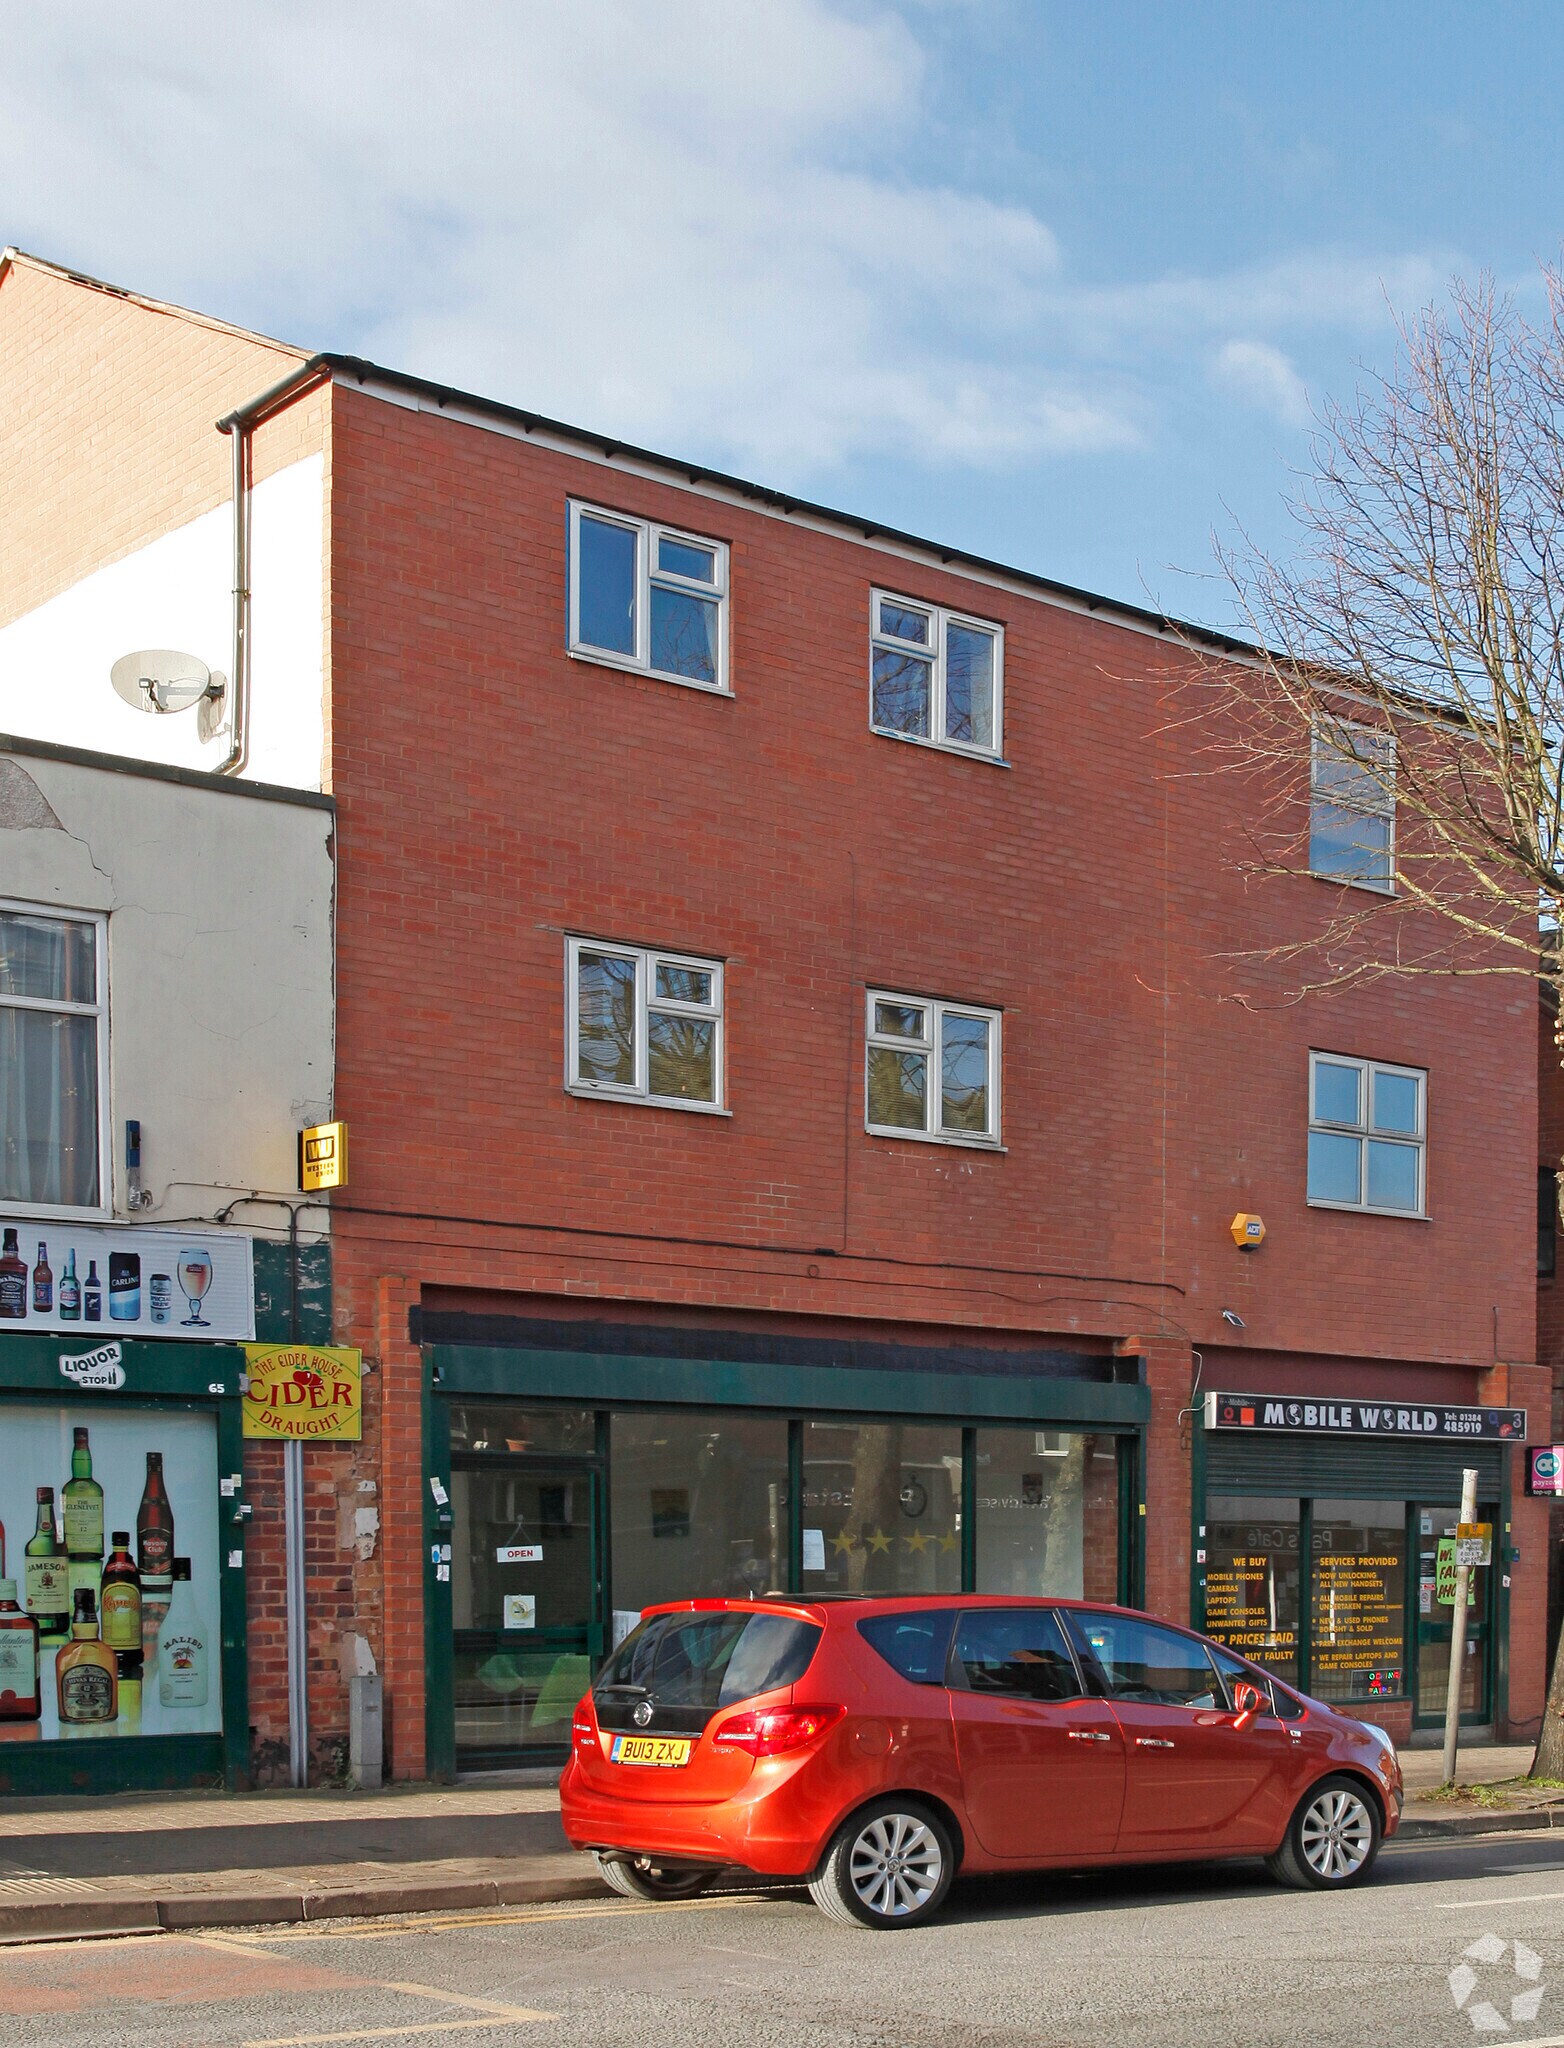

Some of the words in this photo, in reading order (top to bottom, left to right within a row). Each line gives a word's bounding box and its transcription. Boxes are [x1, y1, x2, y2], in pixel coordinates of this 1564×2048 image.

[306, 1162, 334, 1172] WESTERN
[315, 1170, 334, 1178] UNION
[112, 1276, 139, 1287] CARLING
[65, 1347, 118, 1372] LIQUOR
[255, 1358, 276, 1376] THE
[278, 1353, 307, 1367] CIDER
[311, 1356, 343, 1379] HOUSE
[82, 1376, 107, 1385] STOP
[208, 1383, 225, 1394] 65
[246, 1379, 353, 1409] CIDER
[259, 1410, 340, 1434] DRAUGHT
[1263, 1403, 1352, 1428] MOBILE
[1359, 1407, 1438, 1431] WORLD
[1444, 1412, 1457, 1421] Tel:
[1459, 1413, 1481, 1422] 01384
[1444, 1421, 1482, 1433] 485919
[1532, 1479, 1563, 1488] payzone
[507, 1549, 533, 1558] OPEN
[1232, 1557, 1246, 1566] WE
[1249, 1557, 1267, 1566] BUY
[1319, 1557, 1356, 1566] SERVICES
[1358, 1557, 1398, 1566] PROVIDED
[28, 1563, 66, 1573] JAMESON
[1206, 1608, 1227, 1616] GAME
[1229, 1607, 1265, 1615] CONSOLES
[1206, 1620, 1246, 1628] UNWANTED
[1248, 1618, 1268, 1627] GIFTS
[163, 1636, 203, 1650] MALIBU
[1229, 1632, 1265, 1645] PRICES
[1269, 1632, 1294, 1643] PAID
[1337, 1639, 1371, 1647] EXCHANGE
[1373, 1637, 1402, 1645] WELCOME
[1244, 1652, 1262, 1661] BUY
[1264, 1651, 1294, 1660] FAULTY
[1331, 1653, 1353, 1661] REPAIR
[1355, 1652, 1382, 1660] LAPTOPS
[623, 1742, 654, 1759] BU13
[656, 1744, 683, 1761] ZXJ
